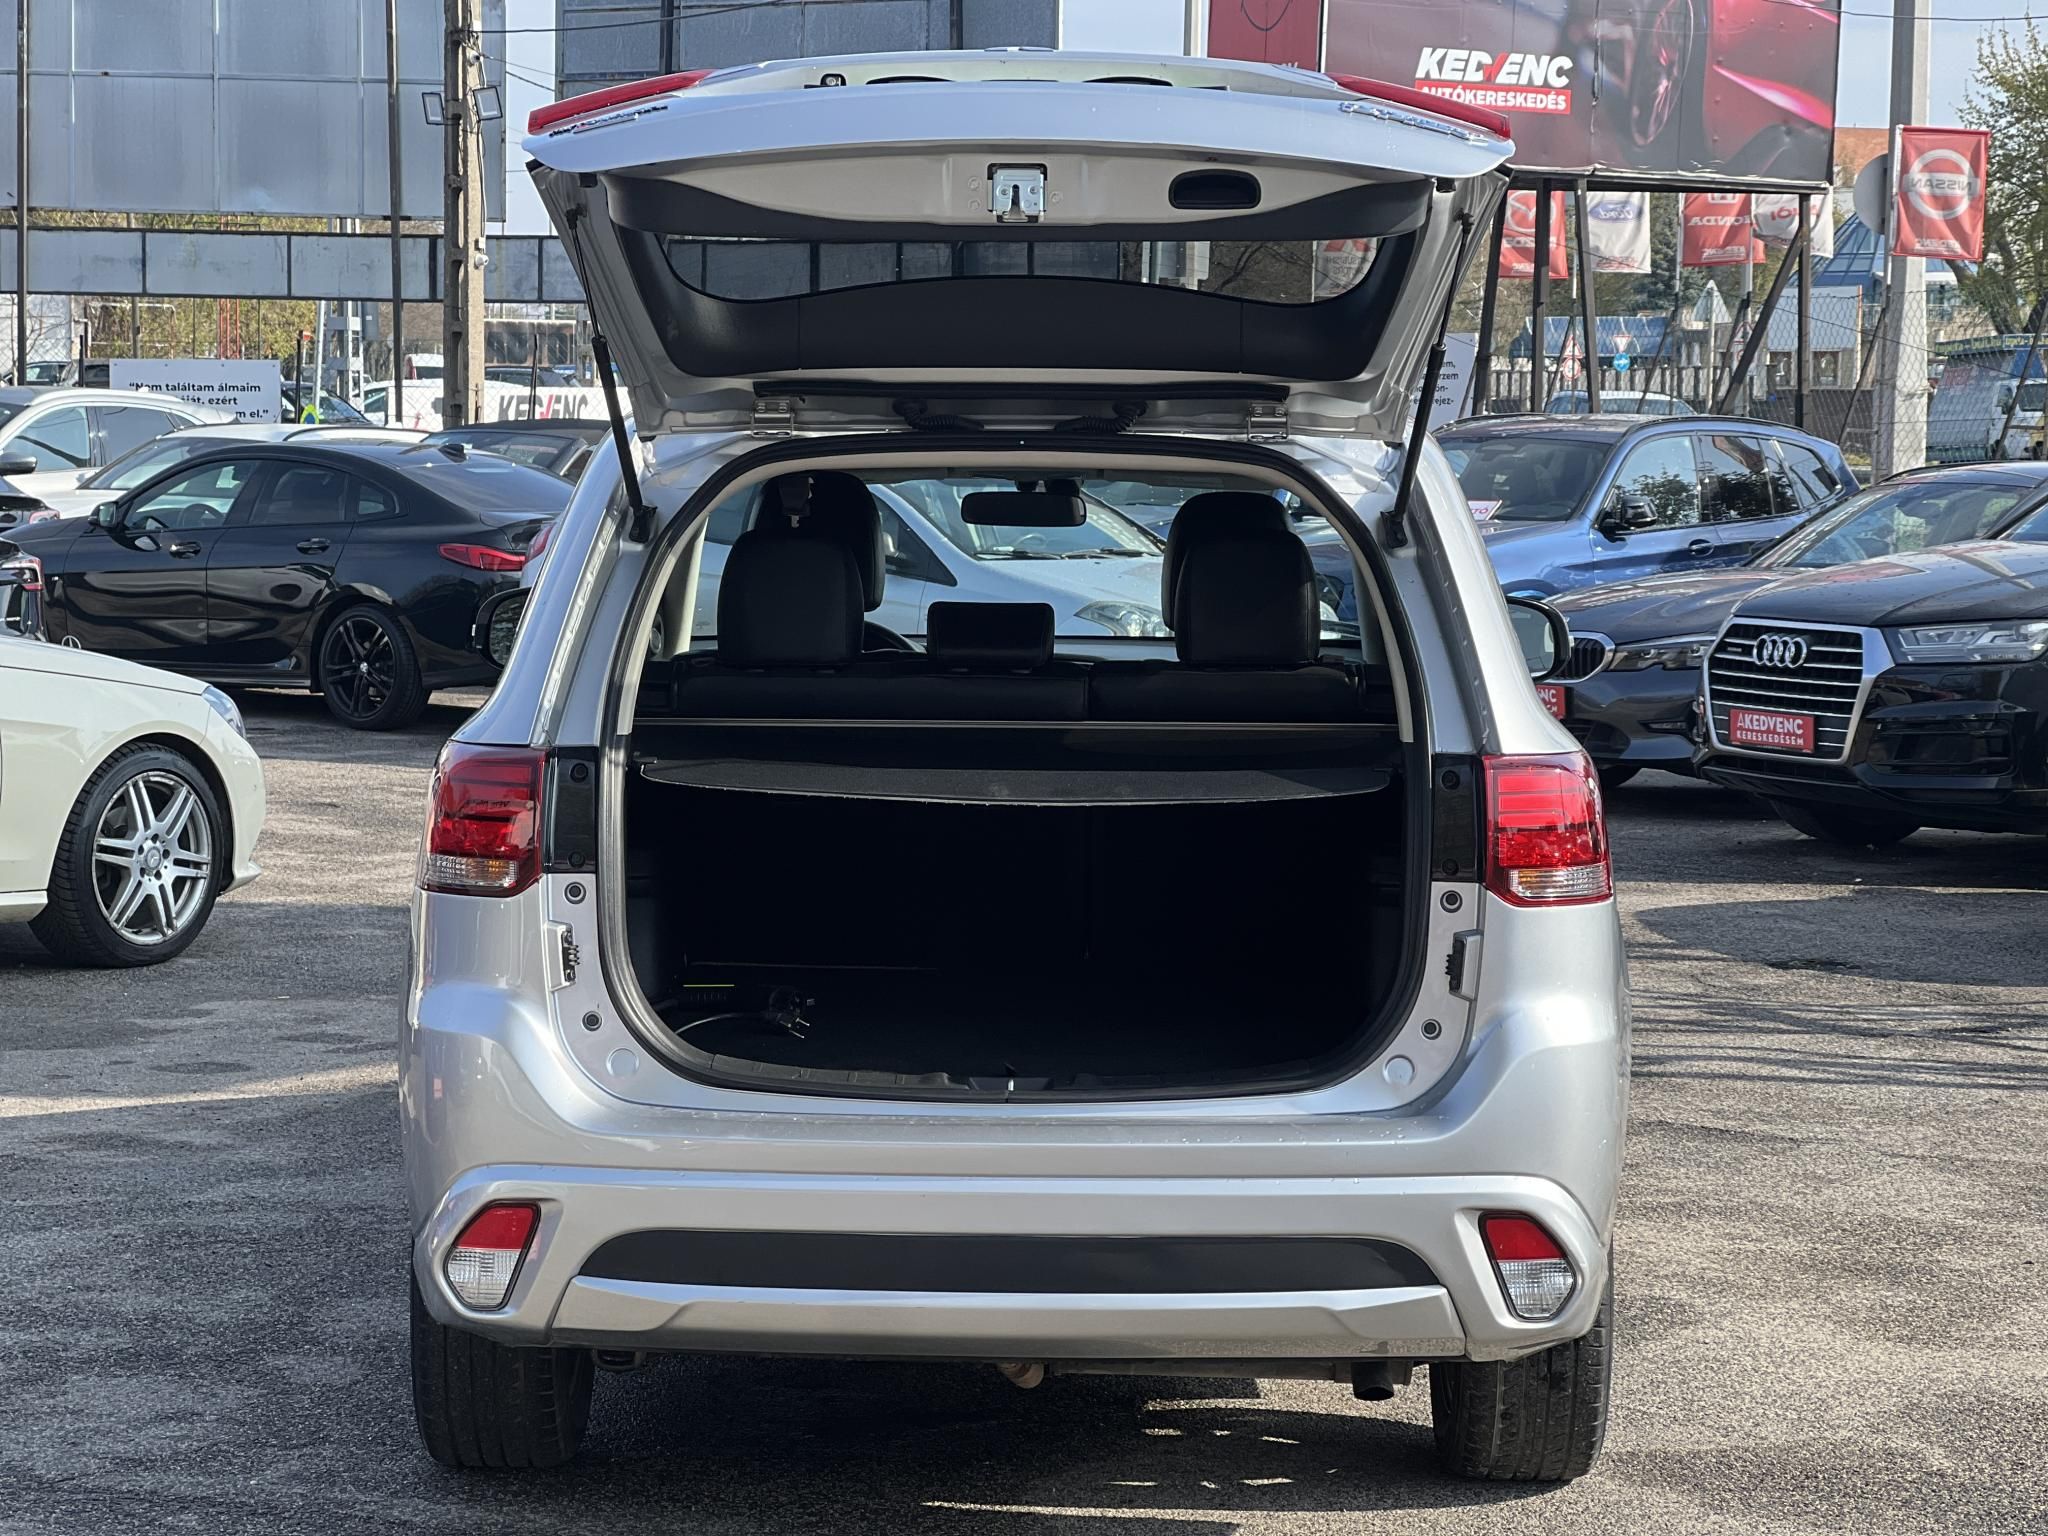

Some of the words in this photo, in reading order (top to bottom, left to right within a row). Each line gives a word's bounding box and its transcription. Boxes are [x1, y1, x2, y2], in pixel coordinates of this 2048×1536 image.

[165, 382, 214, 392] találtam
[218, 382, 261, 392] álmaim
[208, 397, 238, 405] ezért
